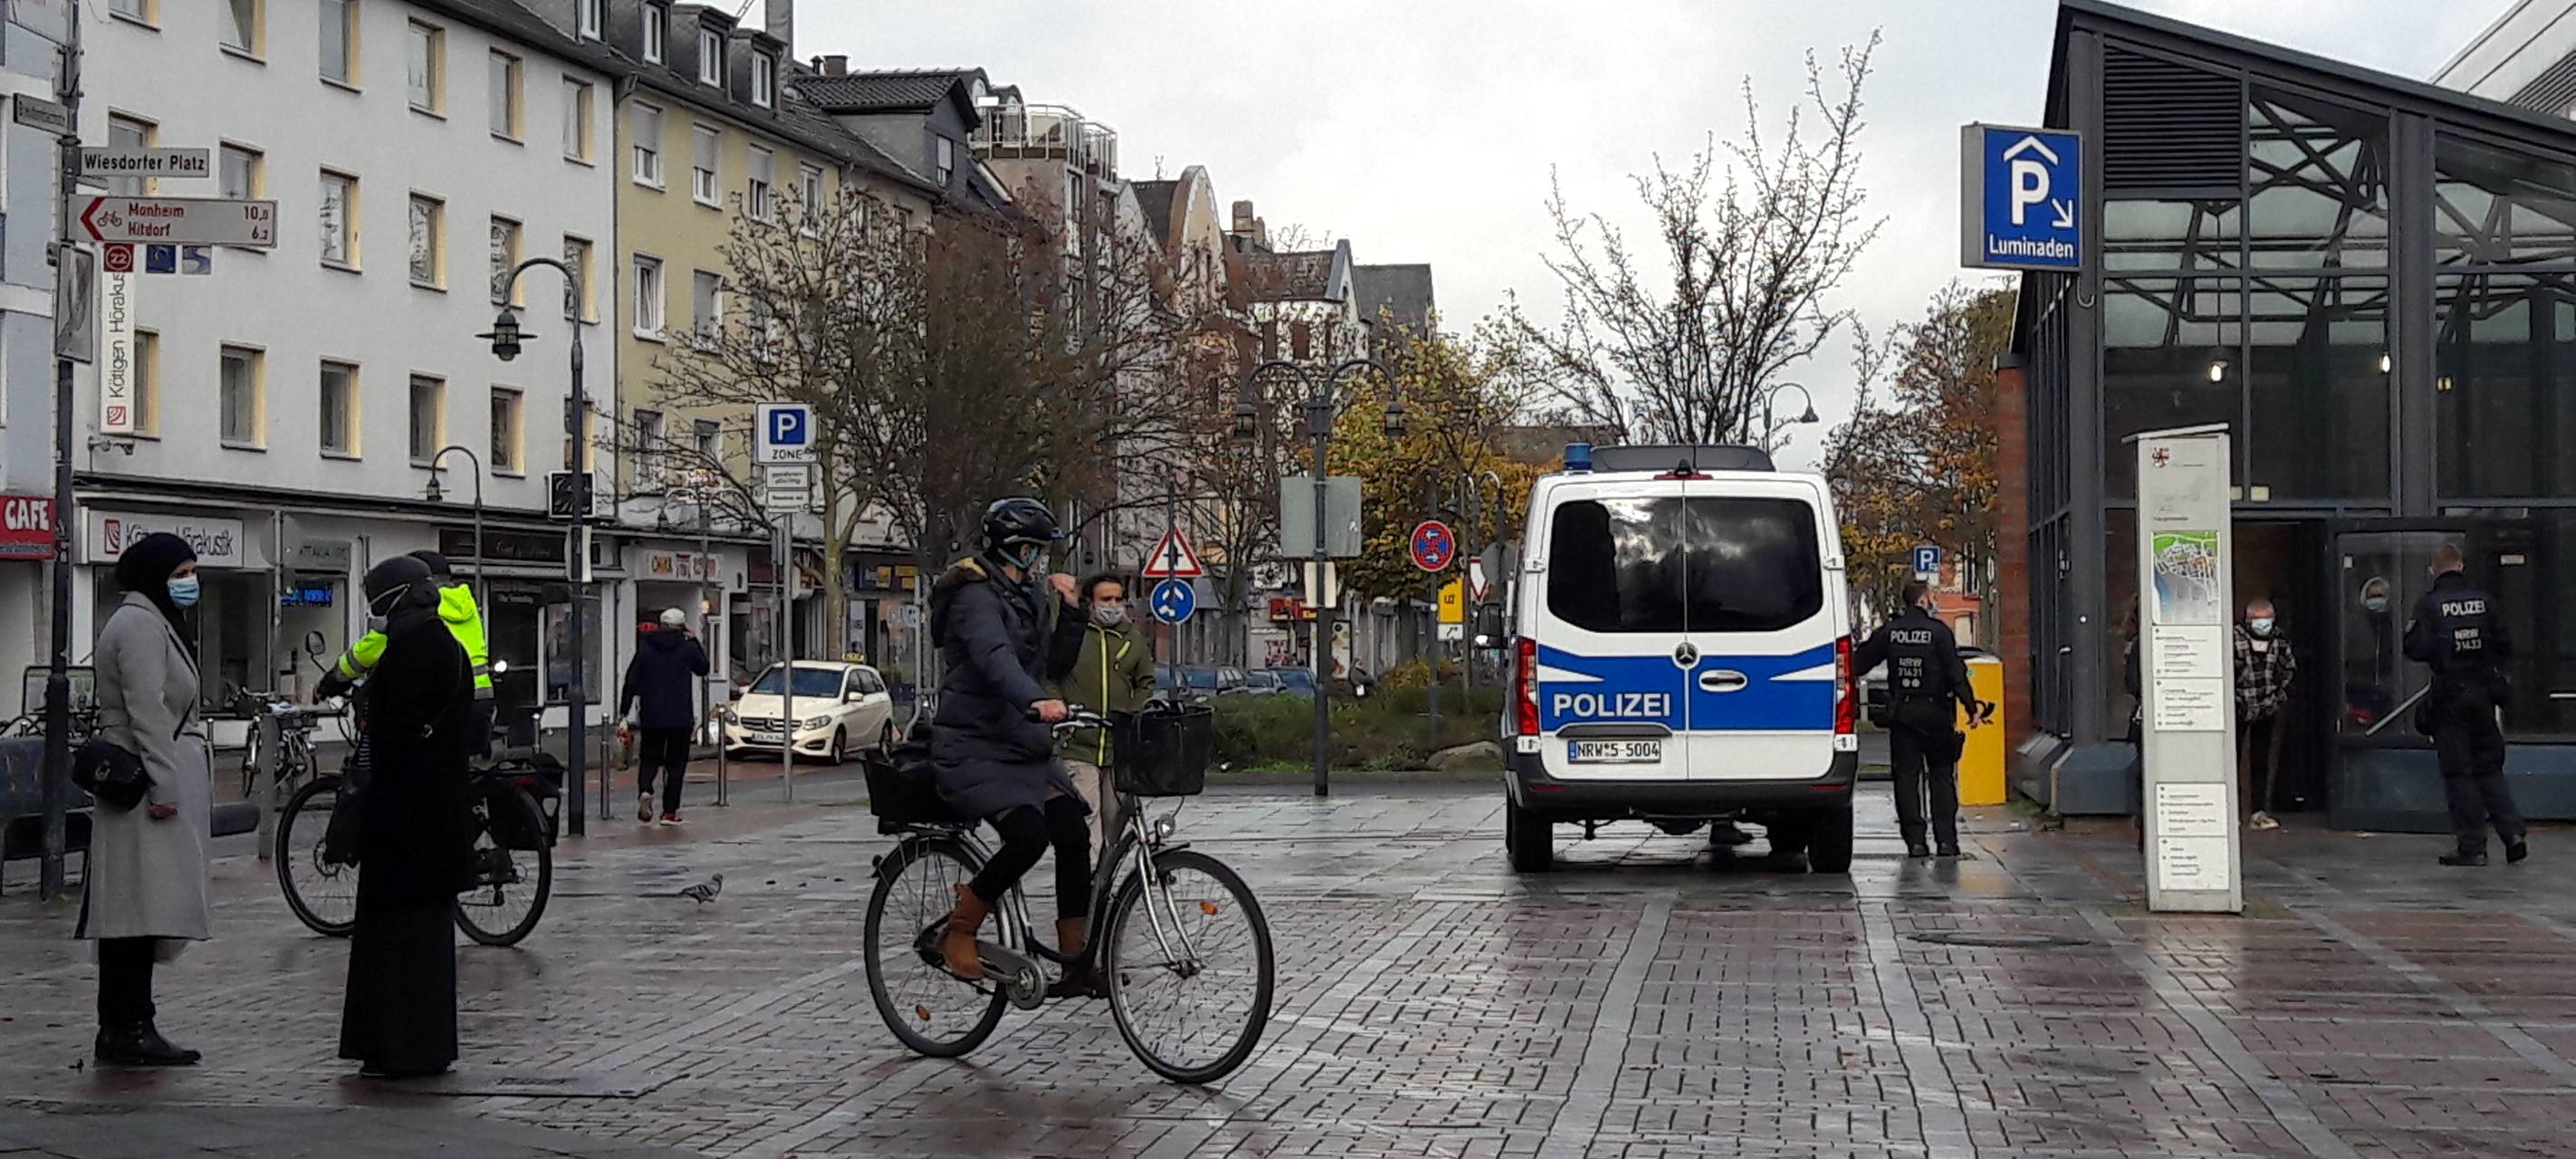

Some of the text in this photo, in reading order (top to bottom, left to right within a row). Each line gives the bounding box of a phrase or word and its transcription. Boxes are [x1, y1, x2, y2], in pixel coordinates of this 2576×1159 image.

[84, 153, 205, 171] Wiesdorfer Platz
[2012, 158, 2051, 225] P
[1989, 234, 2074, 258] Luminaden
[777, 413, 797, 441] P
[771, 449, 803, 460] ZONE
[5, 499, 50, 532] CAFE
[1890, 630, 1932, 644] POLIZEI
[1553, 693, 1670, 718] POLIZEI
[1578, 742, 1660, 757] NRW 5-5004
